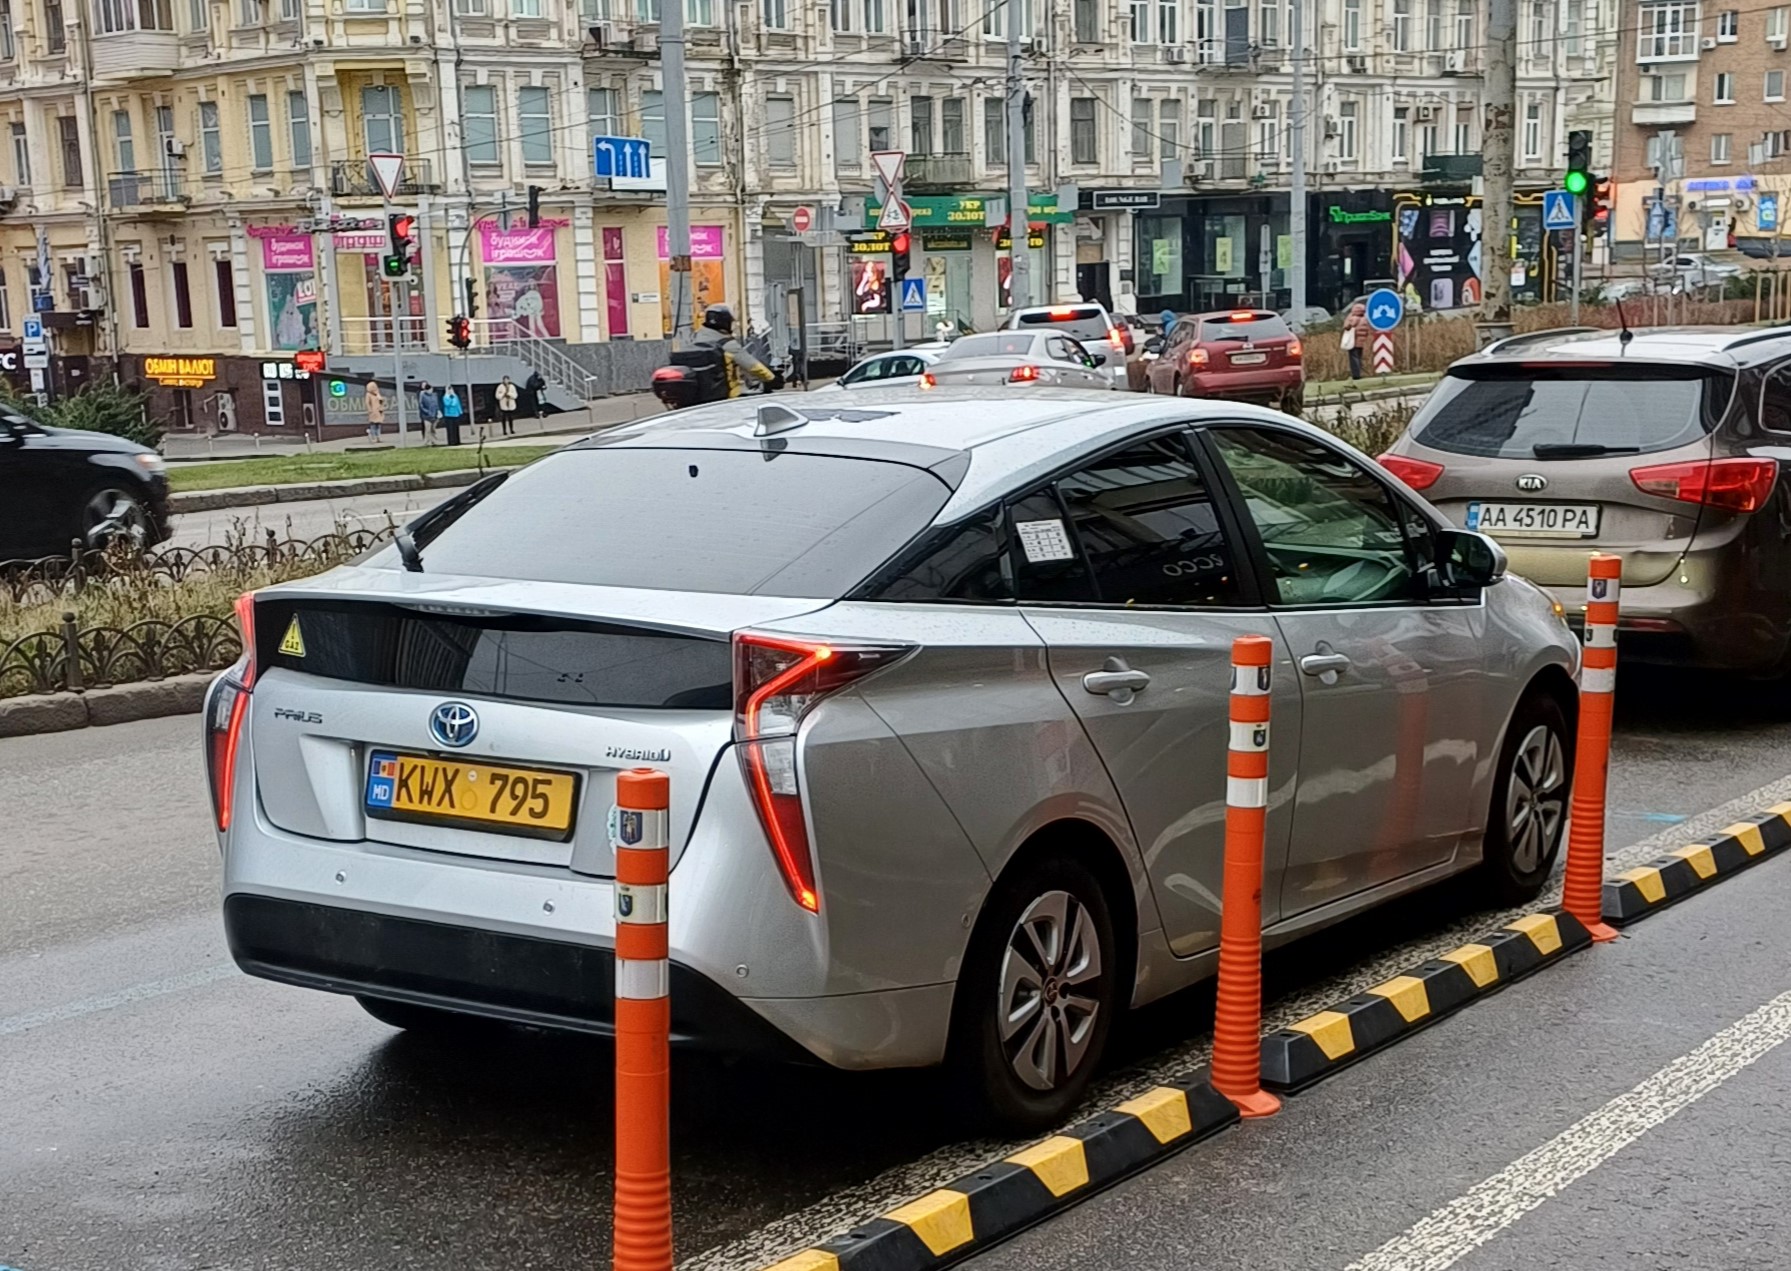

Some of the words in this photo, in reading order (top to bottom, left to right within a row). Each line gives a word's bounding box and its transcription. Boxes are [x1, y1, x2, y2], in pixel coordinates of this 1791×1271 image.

[959, 200, 981, 209] УКР
[947, 211, 986, 221] ЗОЛОТ
[852, 242, 891, 251] ЗОЛОТ
[327, 396, 366, 411] ОБМІ
[1518, 478, 1541, 489] KIA
[1480, 507, 1507, 527] AA
[1513, 508, 1558, 528] 4510
[1562, 509, 1589, 529] PA
[285, 640, 299, 651] GAZ
[274, 707, 323, 724] PRIUS
[372, 784, 389, 800] MD
[395, 762, 460, 809] KWX
[489, 772, 553, 819] 795
